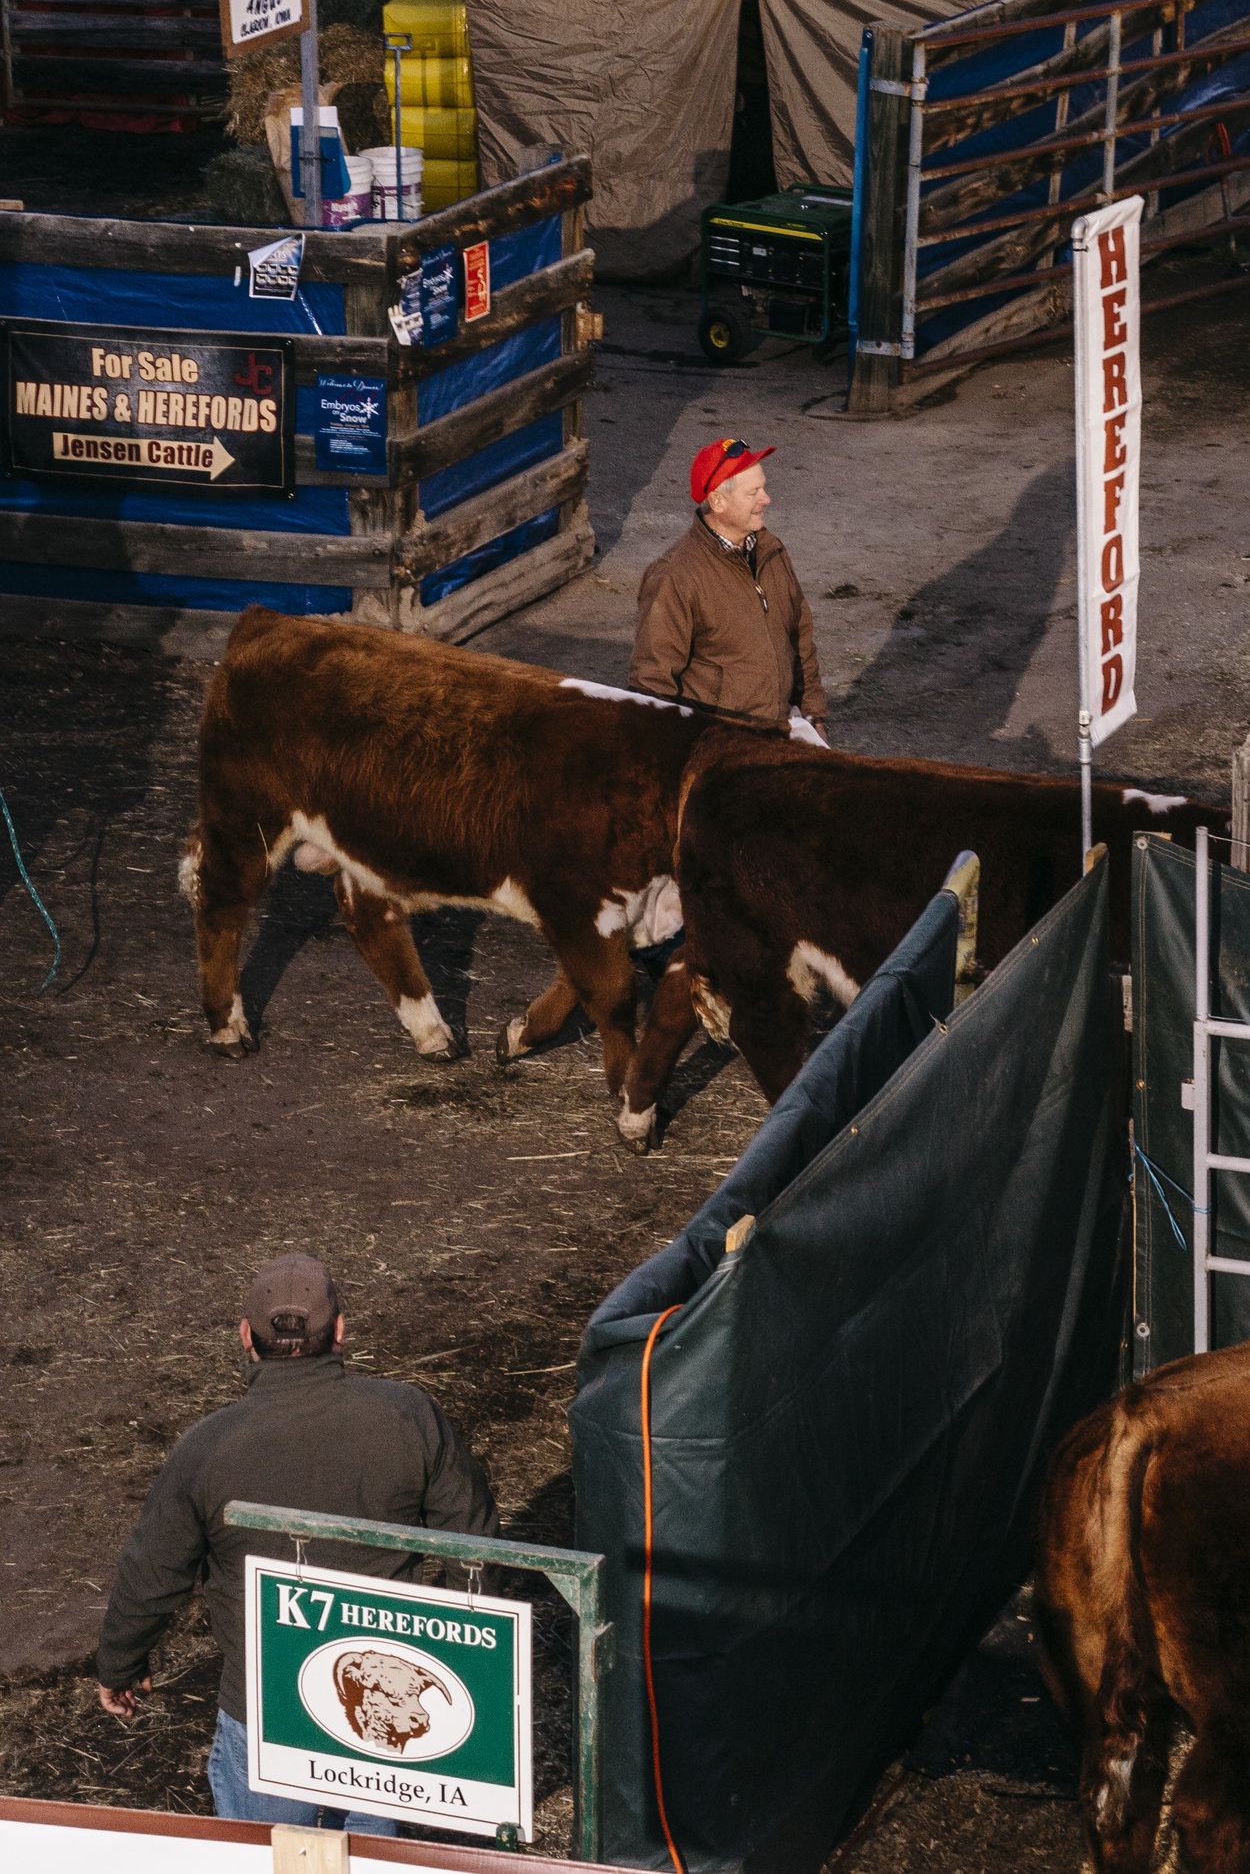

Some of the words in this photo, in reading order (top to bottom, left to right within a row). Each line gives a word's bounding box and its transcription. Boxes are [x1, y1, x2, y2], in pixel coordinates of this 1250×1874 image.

[91, 347, 134, 379] For
[137, 351, 200, 384] Sale
[16, 381, 108, 421] MAINES
[114, 393, 132, 423] &
[137, 389, 278, 433] HEREFORDS
[320, 399, 361, 413] Embryos
[339, 412, 368, 423] Snow
[60, 434, 141, 463] Jensen
[146, 441, 214, 469] Cattle
[1098, 224, 1128, 718] HEREFORD
[275, 1583, 336, 1632] K7
[340, 1603, 497, 1650] HEREFORDS
[308, 1760, 432, 1805] Lockridge,
[438, 1783, 469, 1807] IA
